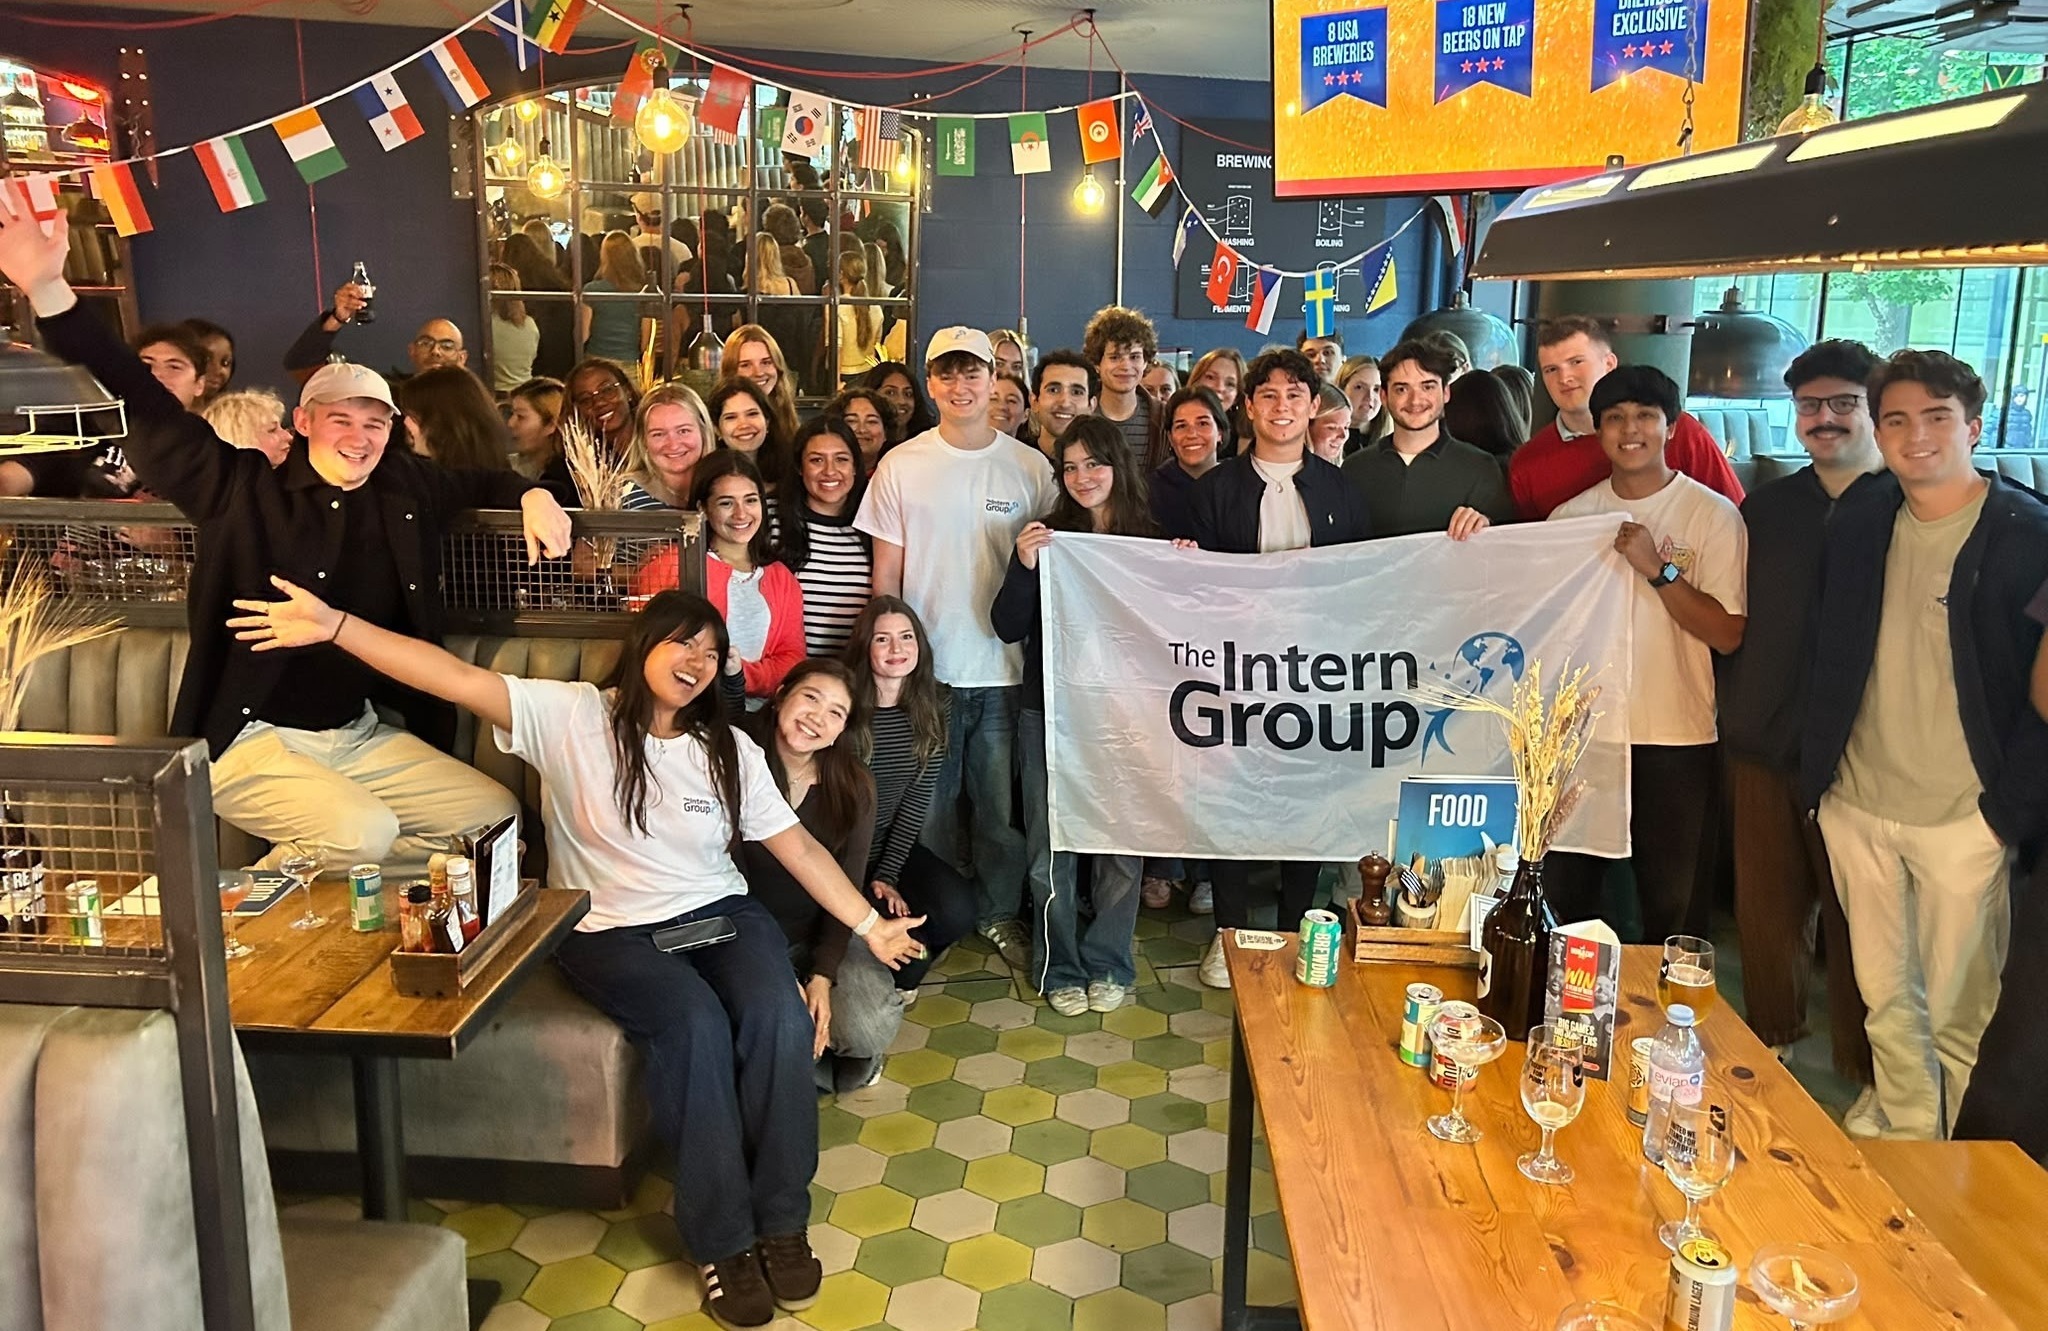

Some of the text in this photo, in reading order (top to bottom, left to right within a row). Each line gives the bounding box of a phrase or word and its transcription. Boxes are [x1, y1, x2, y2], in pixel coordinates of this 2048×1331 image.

[1462, 2, 1506, 28] 18 NEW
[1612, 6, 1688, 36] EXCLUSIVE
[1327, 19, 1359, 42] 8 USA
[1443, 24, 1525, 54] BEERS ON TAP
[1313, 41, 1374, 67] BREWERIES
[986, 503, 1011, 514] Group
[1168, 641, 1418, 693] The Intern
[1169, 680, 1420, 768] Group
[684, 802, 711, 815] Group
[1428, 794, 1488, 827] FOOD
[1310, 932, 1332, 986] BREWDOG
[1566, 966, 1597, 990] WIN
[1557, 1017, 1596, 1036] BIG GAMES
[1654, 1071, 1689, 1087] evian
[1690, 1280, 1704, 1305] LAGER
